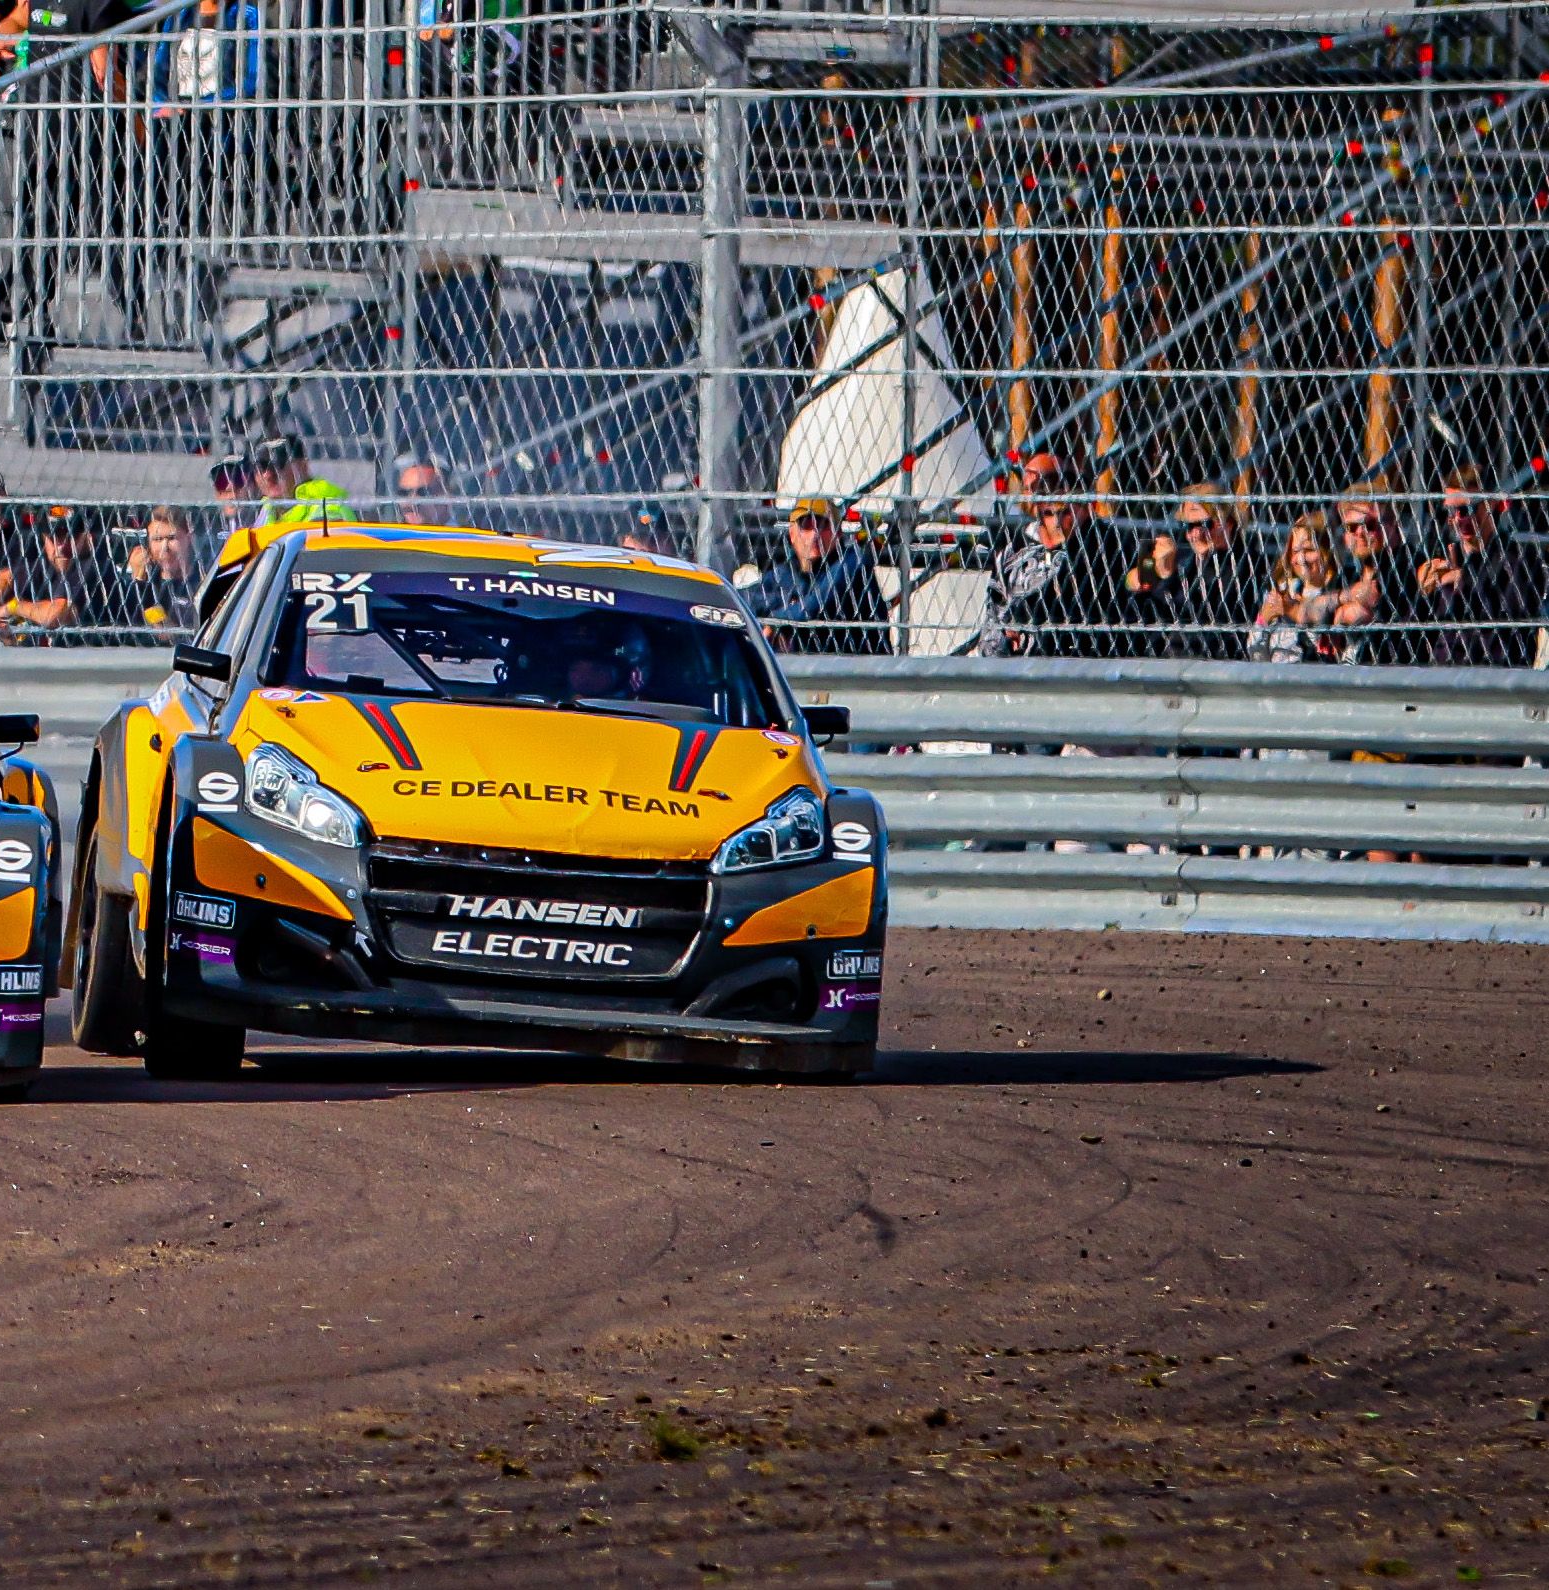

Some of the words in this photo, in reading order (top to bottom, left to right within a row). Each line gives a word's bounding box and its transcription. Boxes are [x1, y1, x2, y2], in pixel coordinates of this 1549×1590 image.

[448, 577, 475, 591] T.
[484, 578, 616, 606] HANSEN
[304, 592, 369, 630] 21
[393, 780, 441, 796] CE
[451, 780, 589, 805] DEALER
[599, 790, 700, 818] TEAM
[176, 894, 231, 924] ÖHLINS
[445, 893, 638, 928] HANSEN
[432, 931, 633, 966] ELECTRIC
